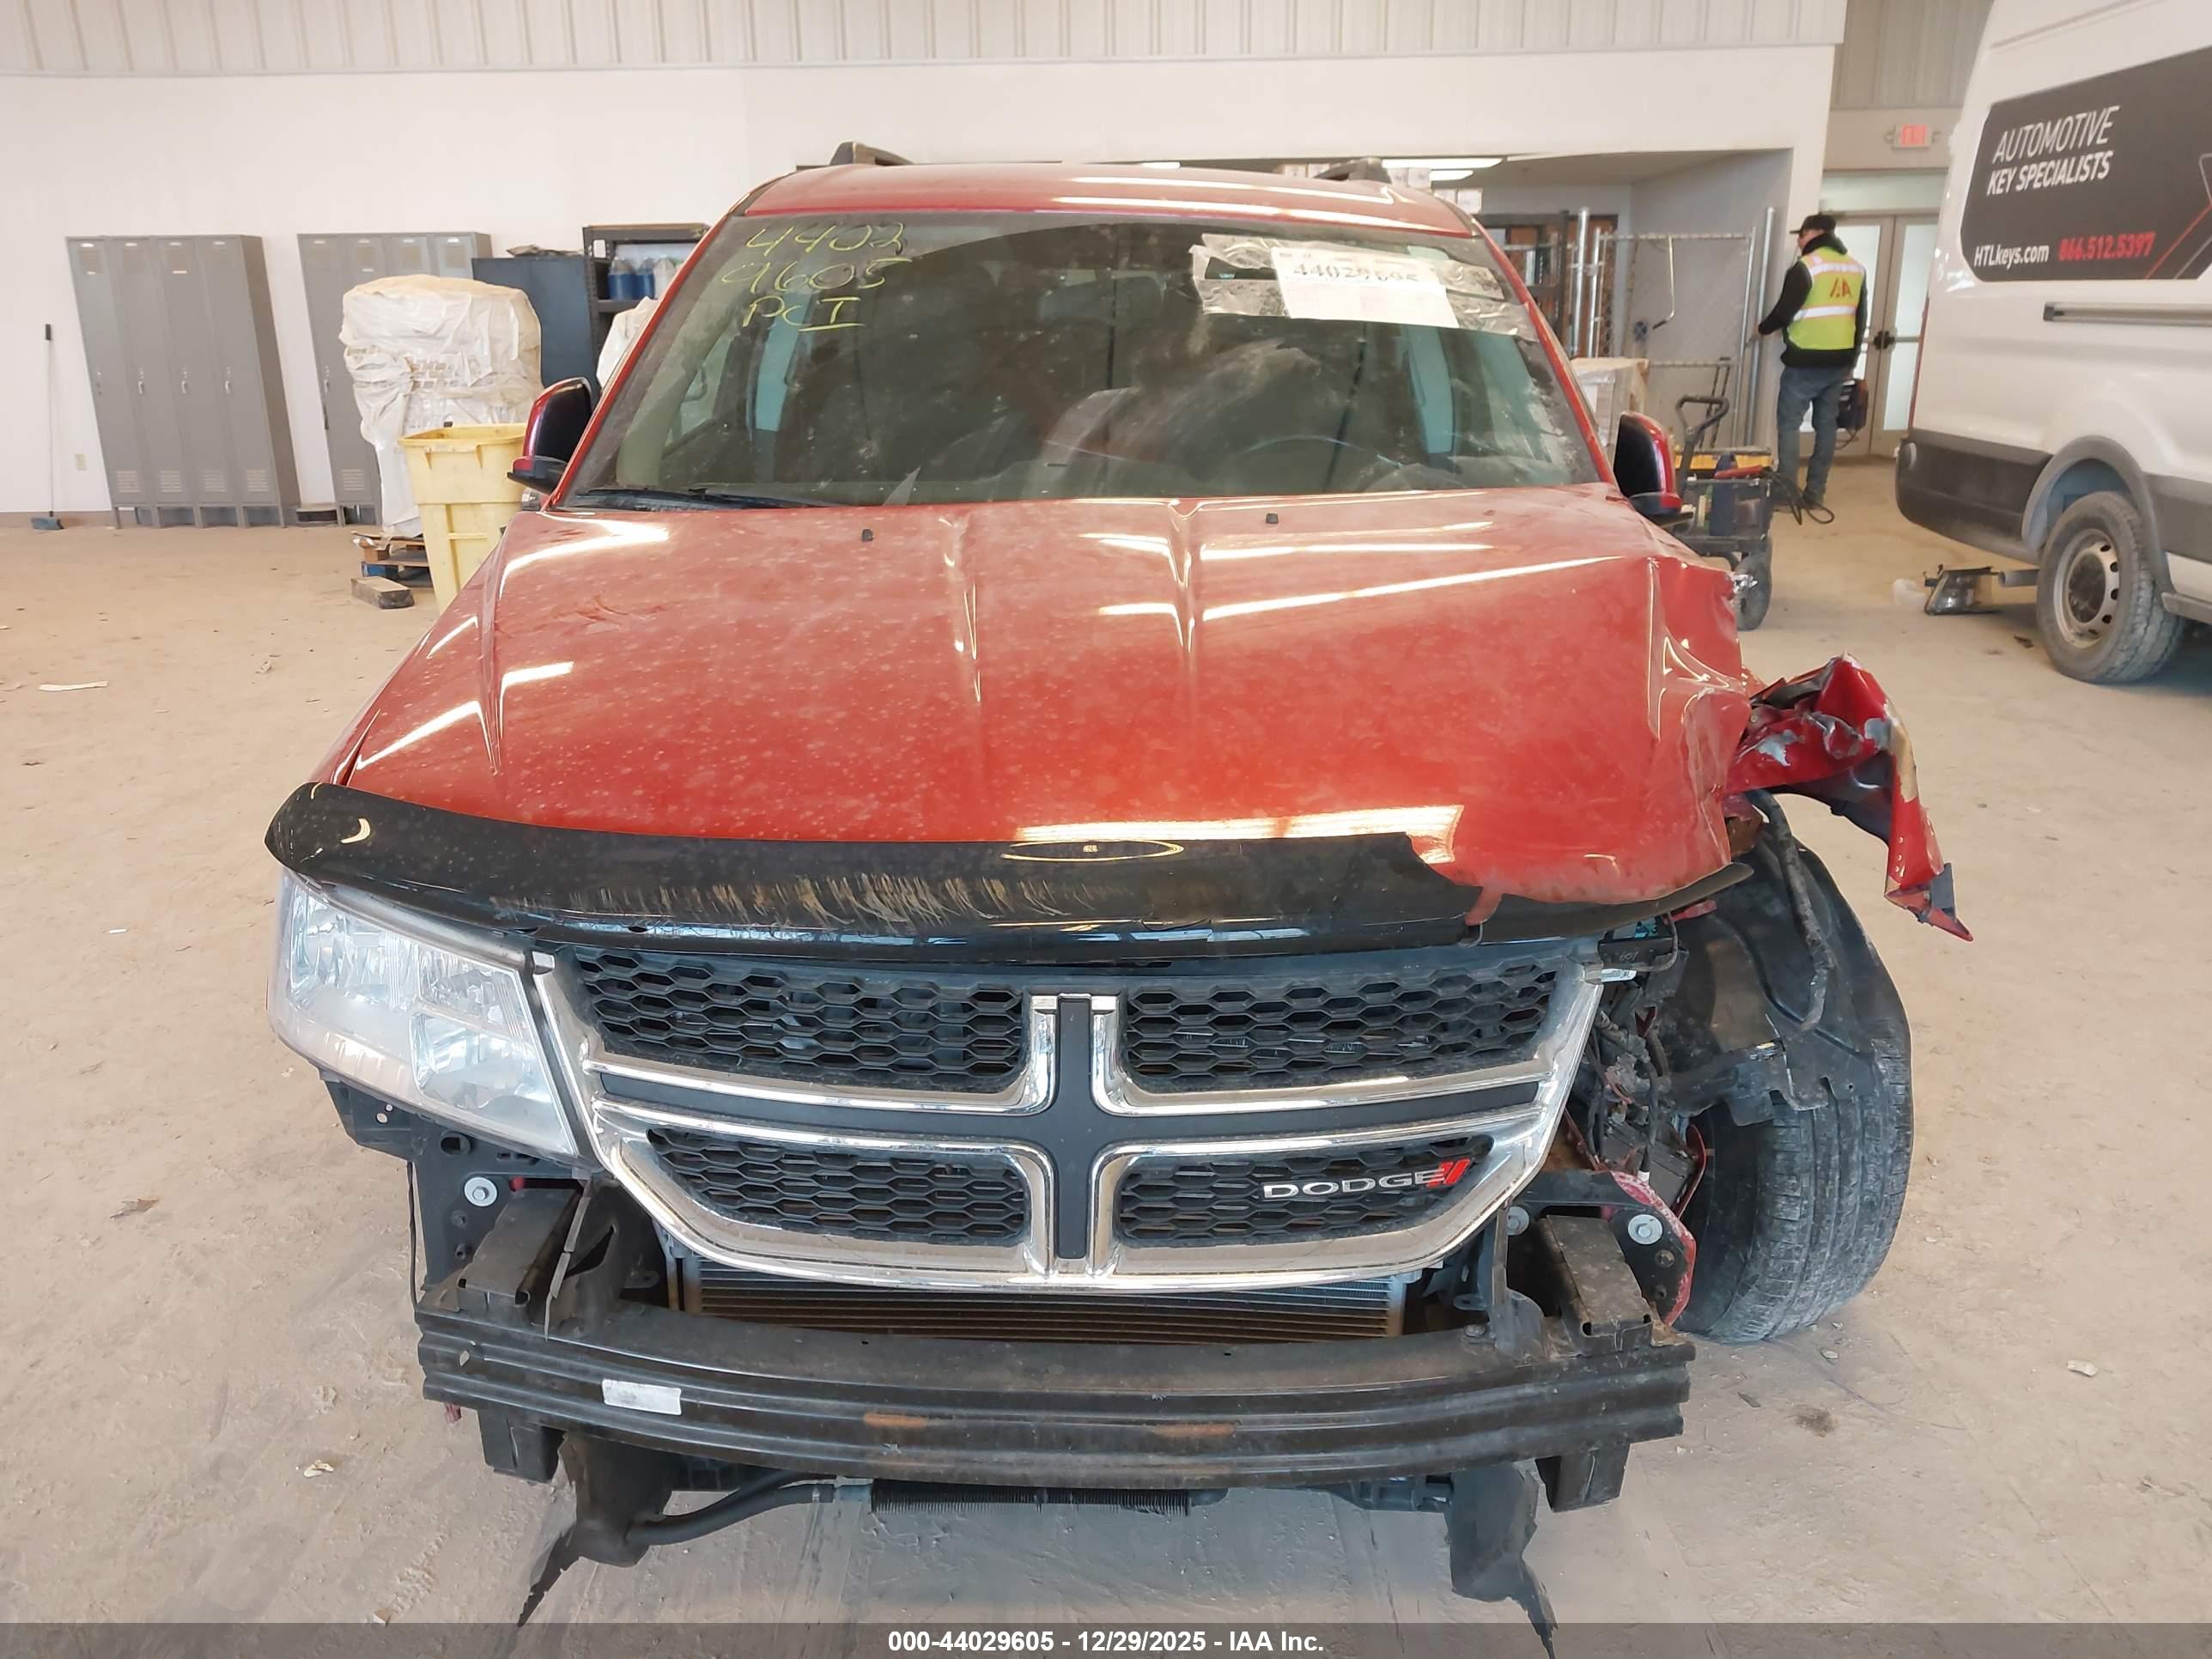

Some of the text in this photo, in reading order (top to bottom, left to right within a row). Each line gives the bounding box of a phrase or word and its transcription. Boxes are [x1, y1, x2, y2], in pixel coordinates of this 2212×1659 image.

[1992, 106, 2120, 163] AUTOMOTIVE
[1986, 150, 2114, 196] KEY SPECIALISTS
[1973, 244, 2050, 270] HTLkeys.com
[1263, 1168, 1445, 1199] DODGE
